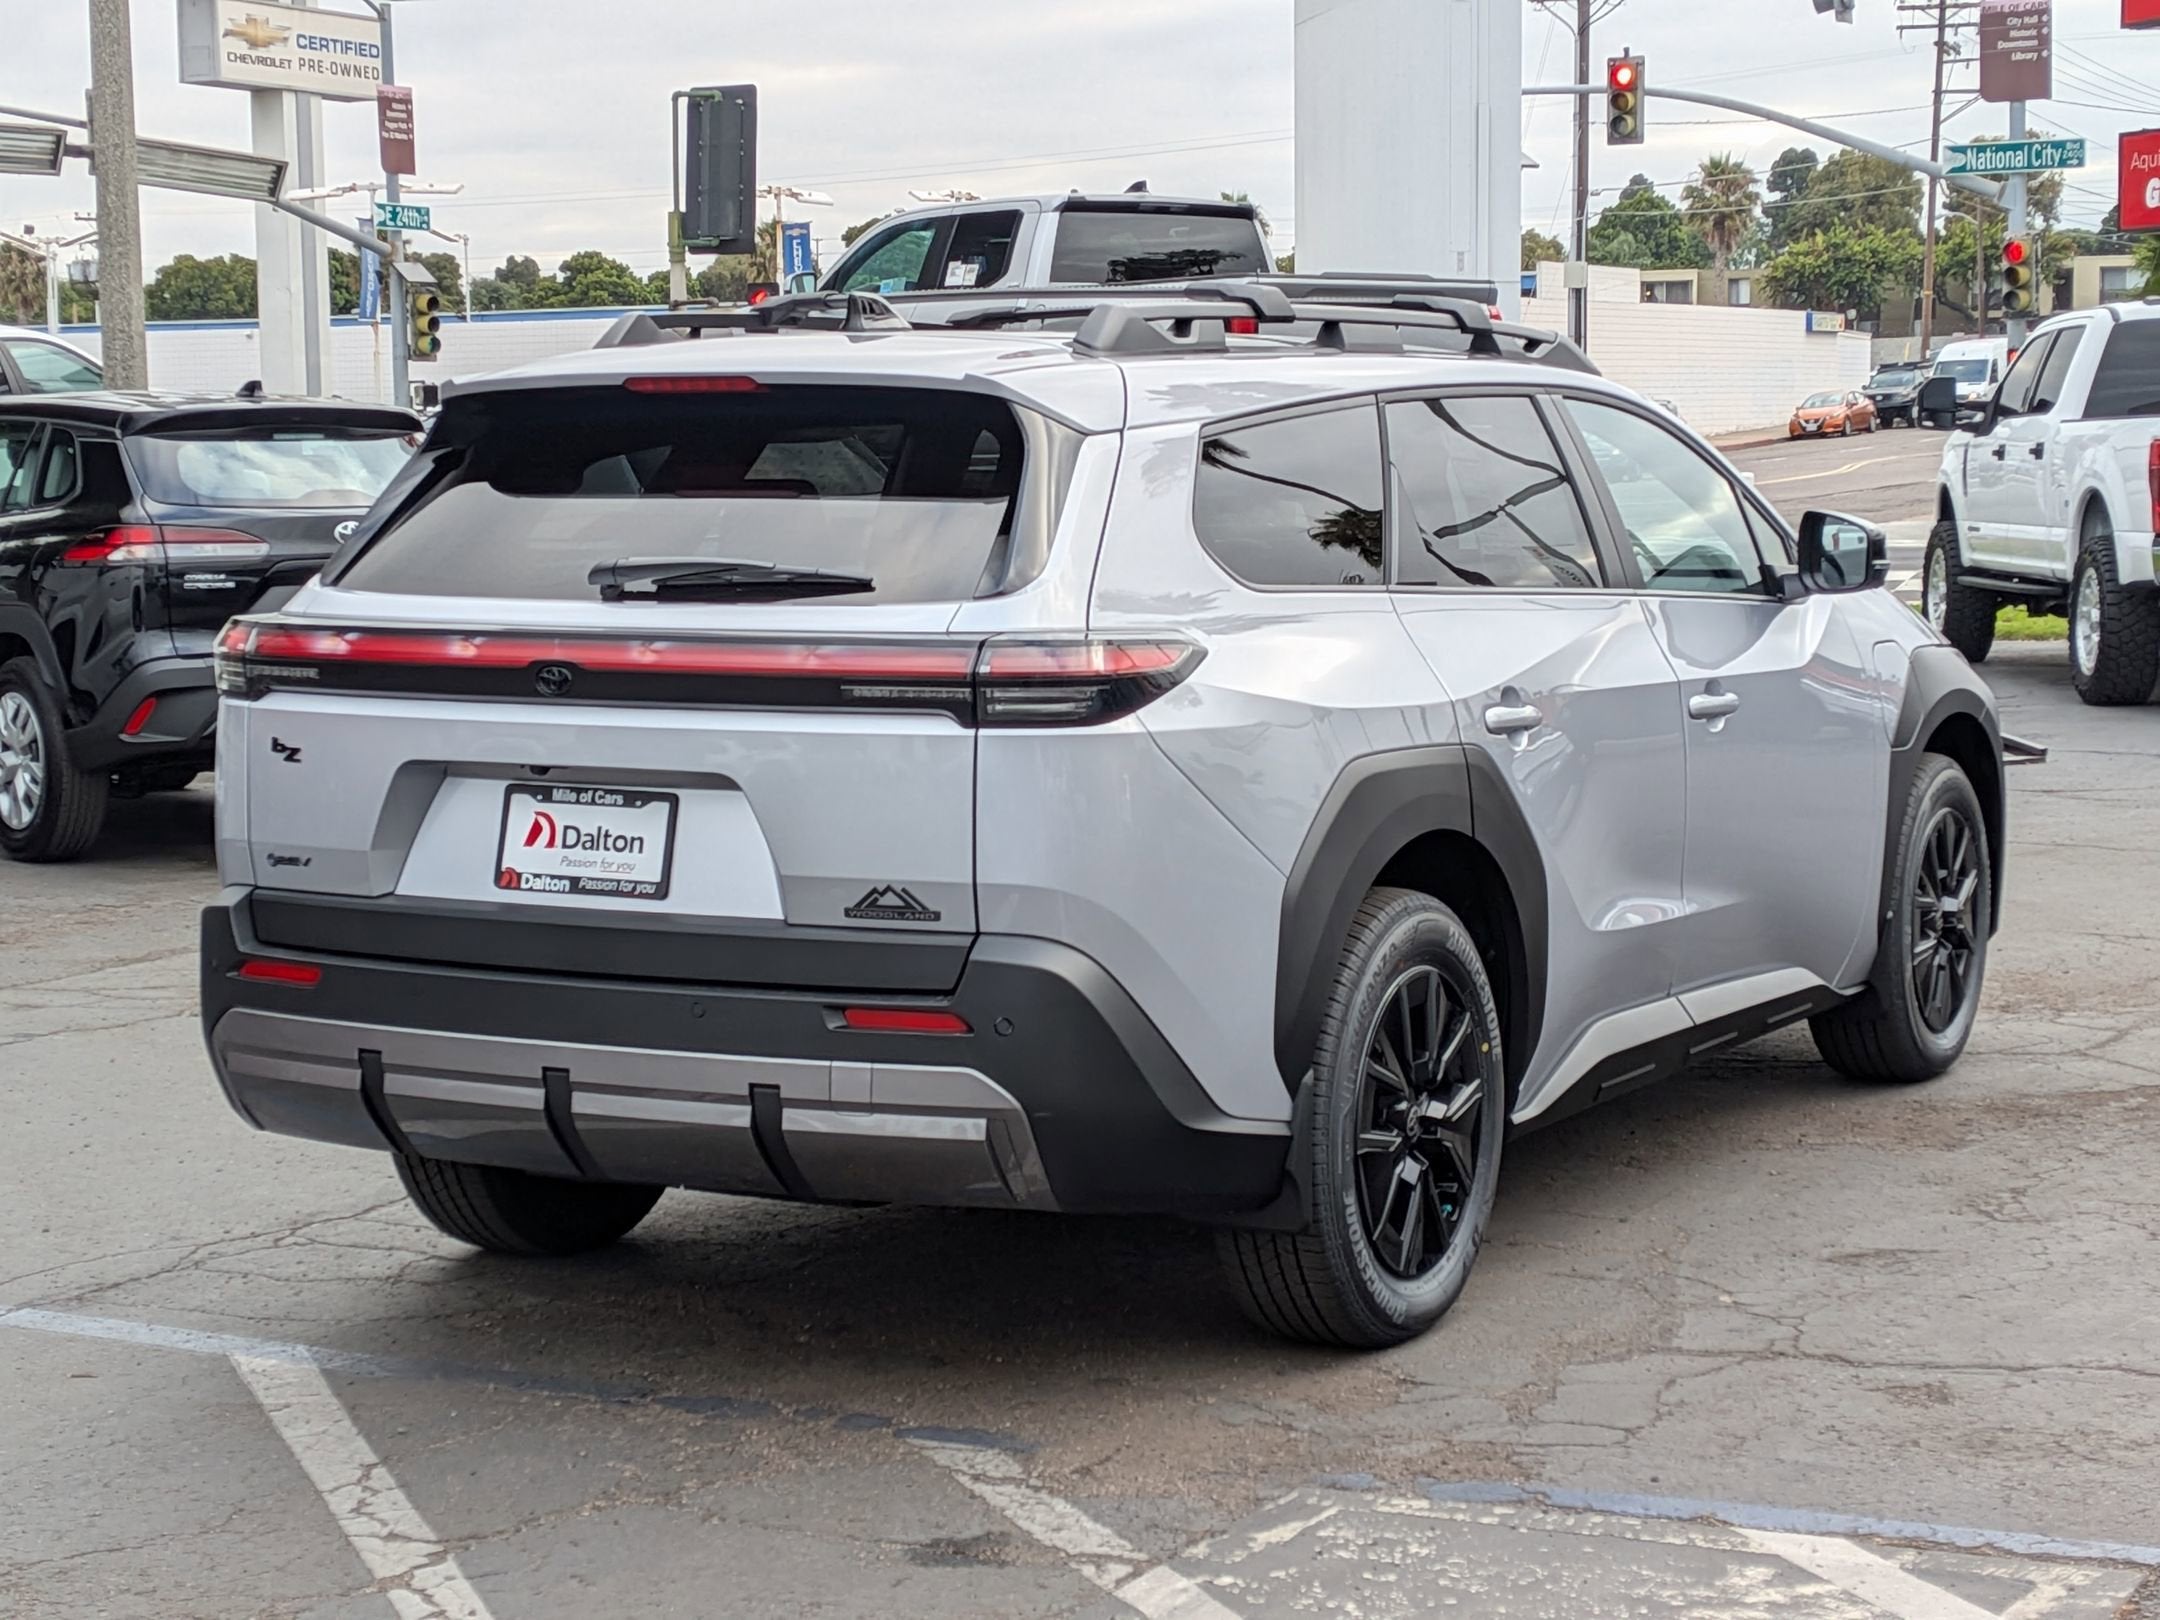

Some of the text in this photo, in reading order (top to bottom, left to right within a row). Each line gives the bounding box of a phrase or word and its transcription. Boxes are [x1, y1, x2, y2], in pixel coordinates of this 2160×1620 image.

[2007, 17, 2022, 27] City
[296, 33, 380, 59] CERTIFIED
[227, 51, 292, 70] CHEVROLET
[298, 57, 380, 80] PRE-OWNED
[1966, 143, 2063, 171] National City
[385, 206, 395, 226] E
[395, 206, 420, 228] 24th
[552, 788, 624, 805] Mile of Cars
[561, 825, 644, 854] Dalton
[560, 856, 636, 873] Passion for you
[520, 873, 657, 895] Dalton Passion for you
[849, 910, 936, 921] WOODLAND
